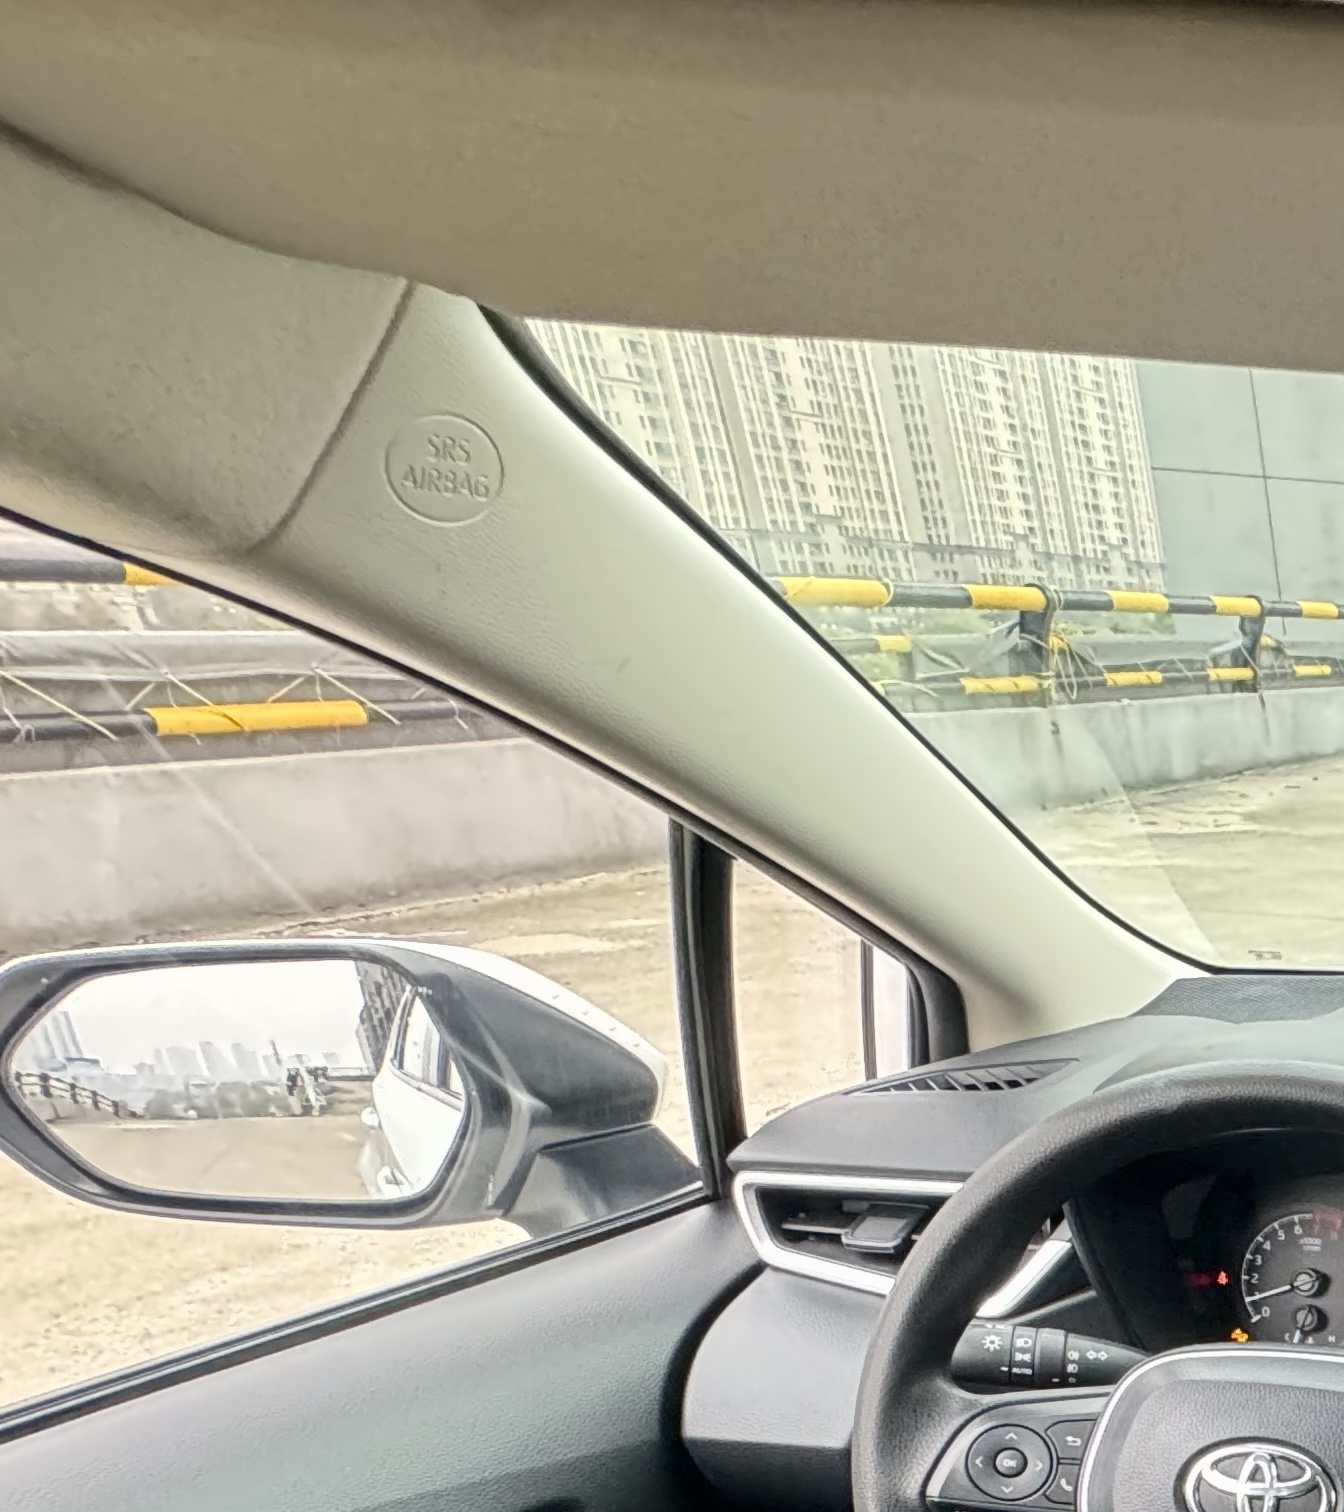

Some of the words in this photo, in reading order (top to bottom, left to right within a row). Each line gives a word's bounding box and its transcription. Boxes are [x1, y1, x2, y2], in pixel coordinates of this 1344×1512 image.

[427, 433, 471, 466] SRS
[401, 464, 490, 502] AIRBAG
[1294, 1223, 1303, 1235] 6
[1277, 1230, 1286, 1240] 5
[1262, 1240, 1271, 1251] 4
[1254, 1254, 1262, 1265] 3
[1250, 1273, 1259, 1284] 2
[1262, 1306, 1271, 1317] 0
[1012, 1367, 1033, 1376] AUTO
[1002, 1459, 1018, 1468] OK
